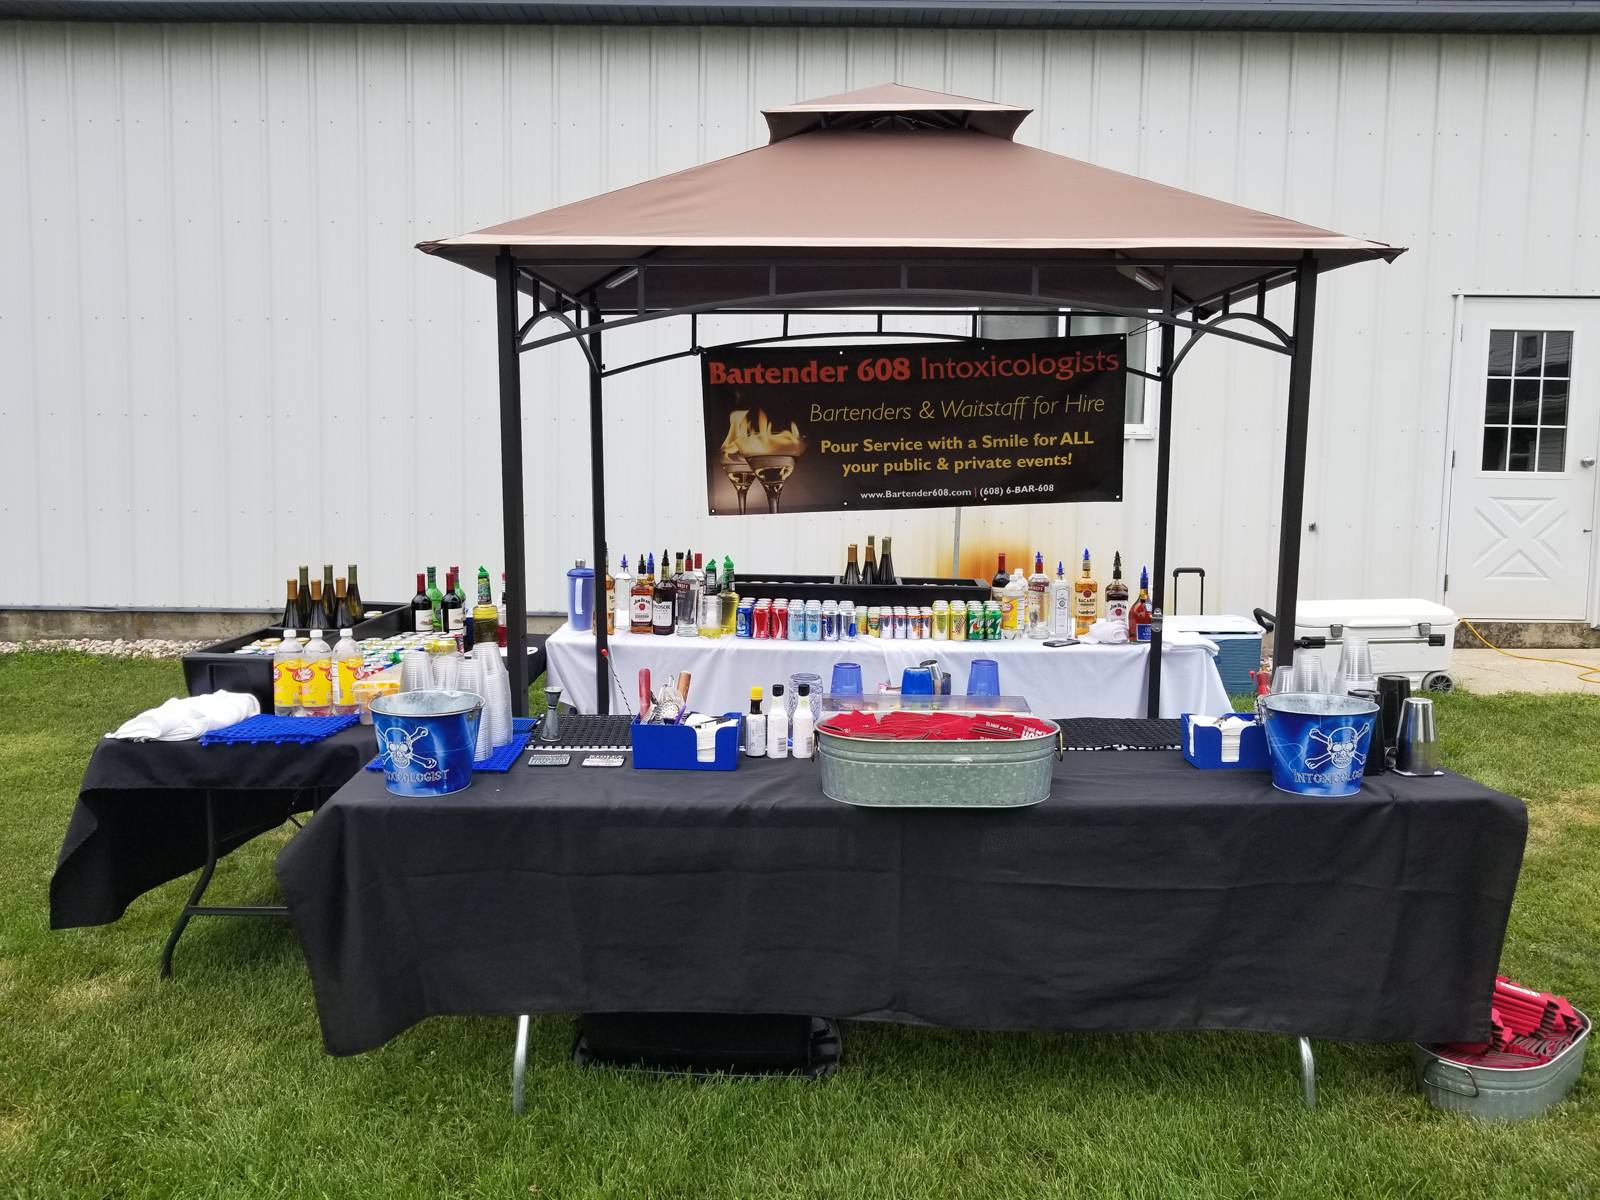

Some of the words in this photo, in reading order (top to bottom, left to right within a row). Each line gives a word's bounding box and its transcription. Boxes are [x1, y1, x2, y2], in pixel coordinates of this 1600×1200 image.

[708, 360, 849, 385] Bartender
[857, 357, 911, 382] 608
[920, 350, 1120, 381] Intoxicologists
[810, 402, 912, 422] Bartenders
[918, 400, 936, 419] &
[941, 396, 1030, 421] Waitstaff
[1032, 395, 1059, 420] for
[1065, 393, 1105, 414] Hire
[820, 440, 859, 454] Pour
[863, 438, 923, 452] Service
[927, 436, 963, 450] with
[967, 439, 978, 449] a
[982, 434, 1029, 448] Smile
[1033, 433, 1058, 447] for
[1060, 431, 1094, 445] ALL
[842, 462, 879, 477] your
[883, 458, 932, 475] public
[936, 457, 949, 471] &
[954, 456, 1012, 473] private
[1016, 452, 1073, 468] events!
[860, 488, 972, 499] www.Bartender608.com
[979, 486, 1004, 497] (608)
[1006, 484, 1054, 495] 6-BAR-608
